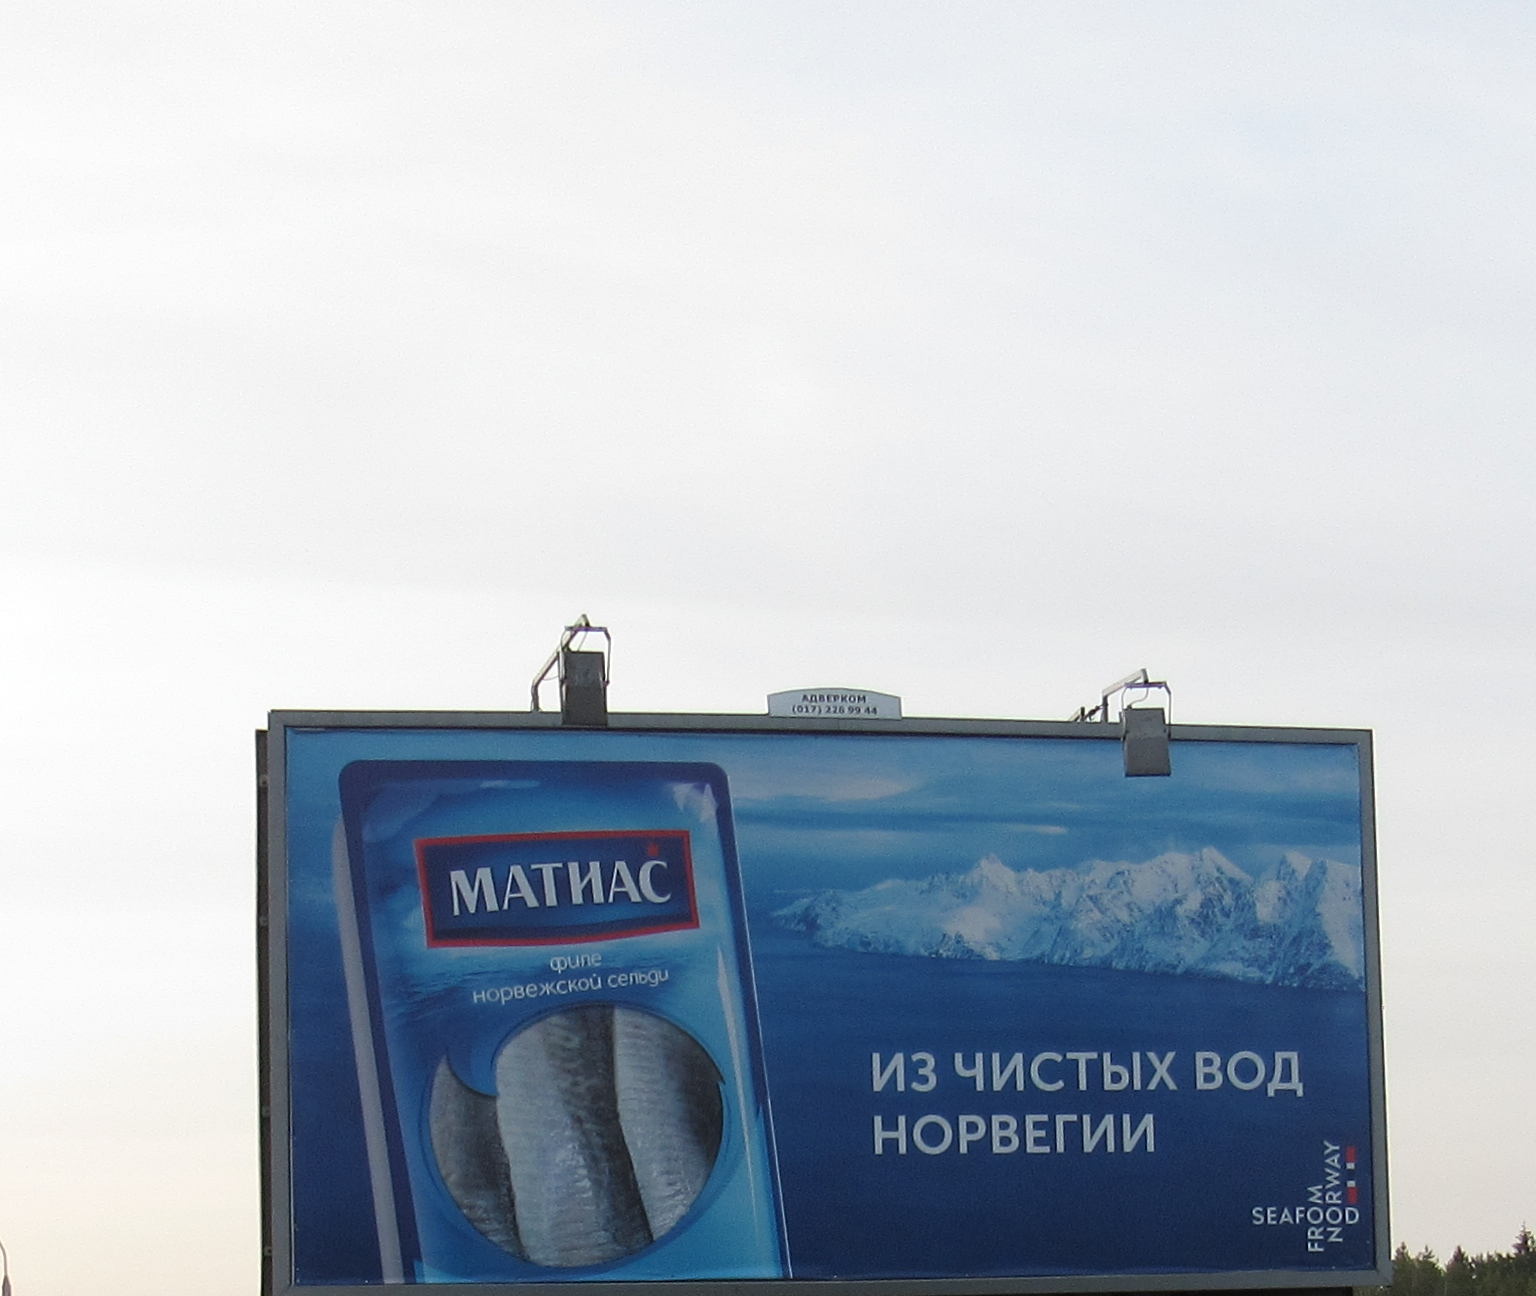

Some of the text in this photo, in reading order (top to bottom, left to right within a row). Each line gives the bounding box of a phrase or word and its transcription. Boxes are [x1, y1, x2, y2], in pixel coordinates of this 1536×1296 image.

[792, 705, 822, 715] (017)
[848, 706, 861, 714] 99
[864, 706, 878, 715] 44
[802, 694, 866, 704] АДВЕРКОМ
[449, 859, 672, 916] МАТИАС
[549, 952, 603, 973] филе
[472, 967, 669, 1005] норвежской сельди
[871, 1050, 1304, 1097] ИЗ ЧИСТЫХ ВОД
[873, 1113, 1155, 1155] НОРВЕГИИ
[1324, 1140, 1343, 1242] NORWAY
[1251, 1206, 1360, 1225] SEAFOOD
[1307, 1185, 1324, 1252] FROM
